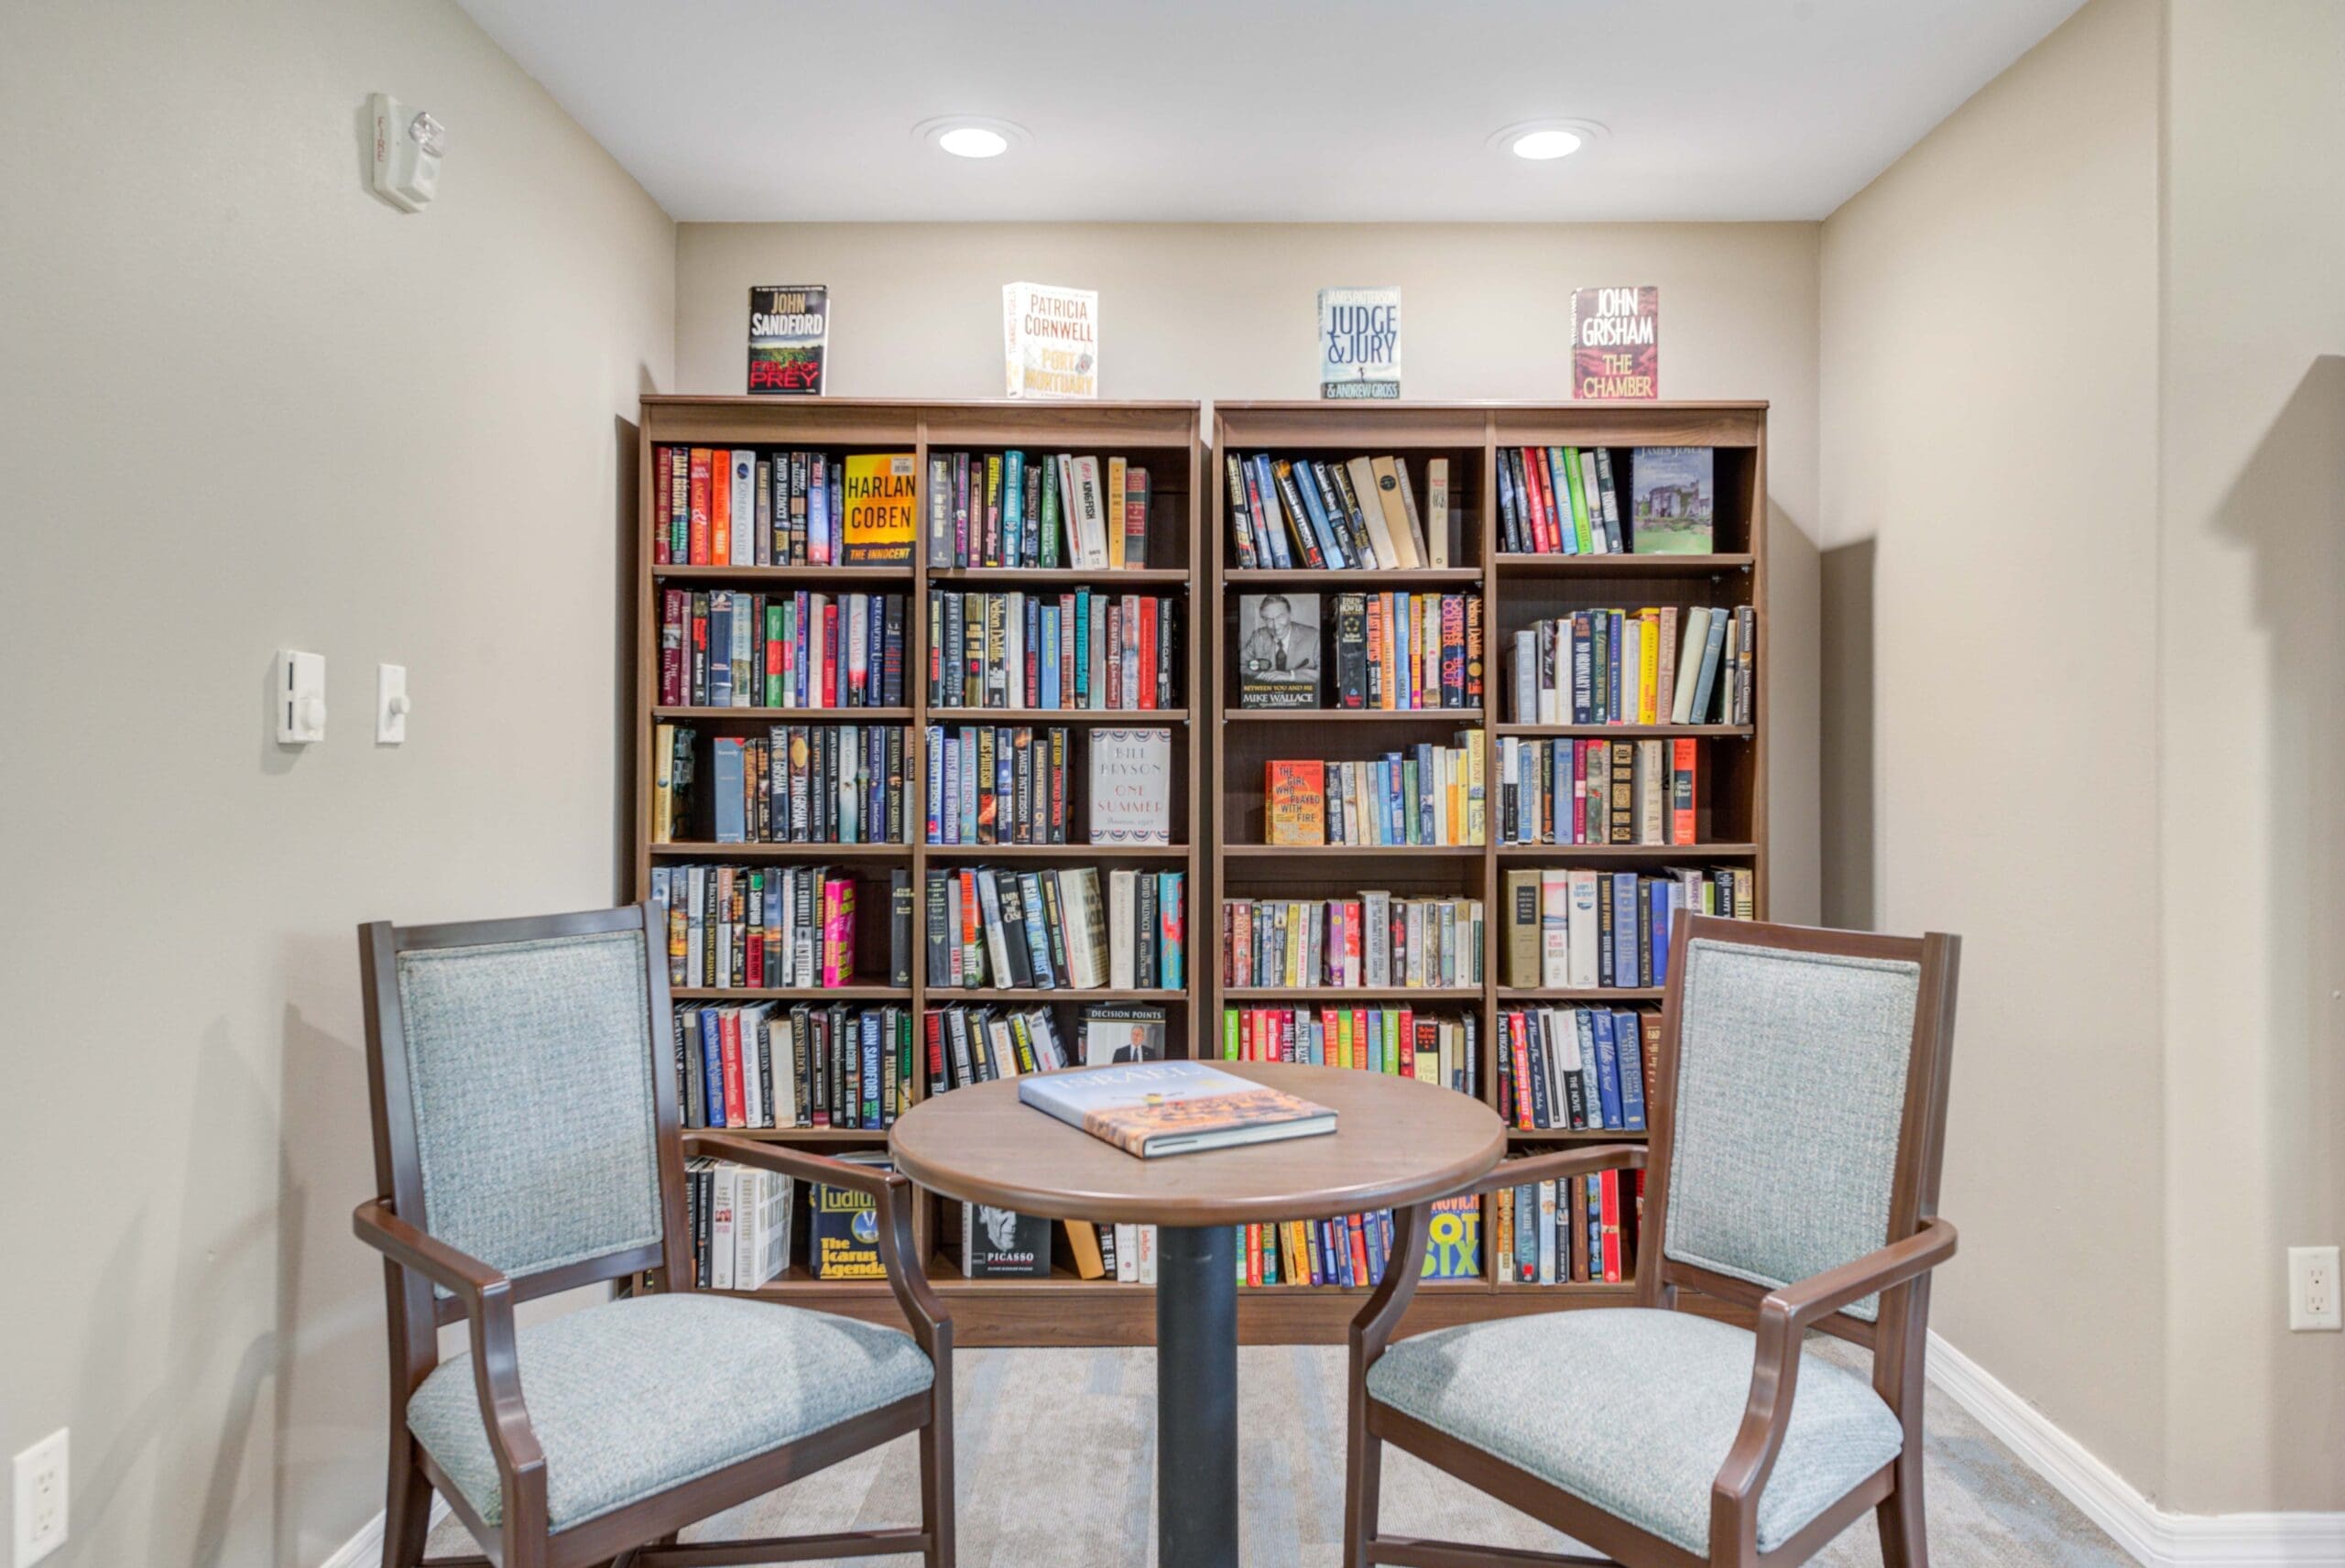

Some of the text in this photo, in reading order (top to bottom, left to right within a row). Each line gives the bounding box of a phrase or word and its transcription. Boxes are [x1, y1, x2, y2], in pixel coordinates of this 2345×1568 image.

[771, 292, 807, 315] JOHN
[1031, 294, 1087, 321] PATRICIA
[1597, 288, 1639, 317] JOHN
[751, 312, 823, 336] SANDFORD
[1025, 314, 1094, 343] CORNWELL
[1326, 306, 1397, 335] JUDGE
[1583, 316, 1654, 346] GRISHAM
[1041, 347, 1074, 371] PORT
[1347, 332, 1398, 364] JURY
[1603, 354, 1633, 376] THE
[750, 371, 820, 388] PREY
[1025, 367, 1094, 397] MORTUARY
[1327, 383, 1399, 398] & ANDREW GROSS
[1583, 376, 1654, 398] CHAMBER
[776, 458, 788, 519] DAVID BALDACCI
[848, 475, 915, 499] HARLAN
[1083, 481, 1096, 519] KINGFISH
[851, 506, 911, 528] COBEN
[949, 595, 958, 661] DARK HARBOR
[989, 598, 1005, 663] Nelson DeMille
[1443, 598, 1454, 646] COULTER
[1454, 599, 1464, 646] CATHERINE
[1576, 643, 1590, 708] NO ORDINARY TIME
[1243, 693, 1314, 702] MIKE WALLACE
[981, 732, 993, 752] JAMES
[772, 729, 785, 794] JOHN GRISHAM
[944, 743, 956, 768] VIOLETS
[930, 732, 939, 815] JAMES PATTERSON
[944, 768, 956, 781] ARE
[1279, 768, 1293, 777] THE
[1287, 776, 1305, 786] GIRL
[944, 781, 956, 797] BLUE
[964, 761, 973, 815] PATTERSON
[1019, 750, 1027, 822] JAMES PATTERSON
[1275, 785, 1295, 795] WHO
[792, 775, 806, 829] JOHN GRISHAM
[1282, 805, 1303, 813] WITH
[1290, 794, 1320, 805] PLAYED
[1297, 813, 1315, 822] FIRE
[1141, 878, 1150, 931] DAVID BALDACCI
[796, 890, 810, 977] CONNOLLY UNQUIET
[964, 944, 976, 975] MOTIVE
[1091, 1010, 1162, 1019] DECISION POINTS
[1499, 1016, 1507, 1063] JACK HIGGINS
[1626, 1022, 1637, 1063] PLAGUE
[863, 1018, 878, 1099] JOHN SANDFORD
[1571, 1090, 1580, 1113] NOVEL
[821, 1237, 850, 1250] The
[822, 1249, 878, 1263] Icarus
[1101, 1234, 1116, 1271] THE FOX
[821, 1260, 889, 1279] Agenda
[987, 1252, 1034, 1262] PICASSO
